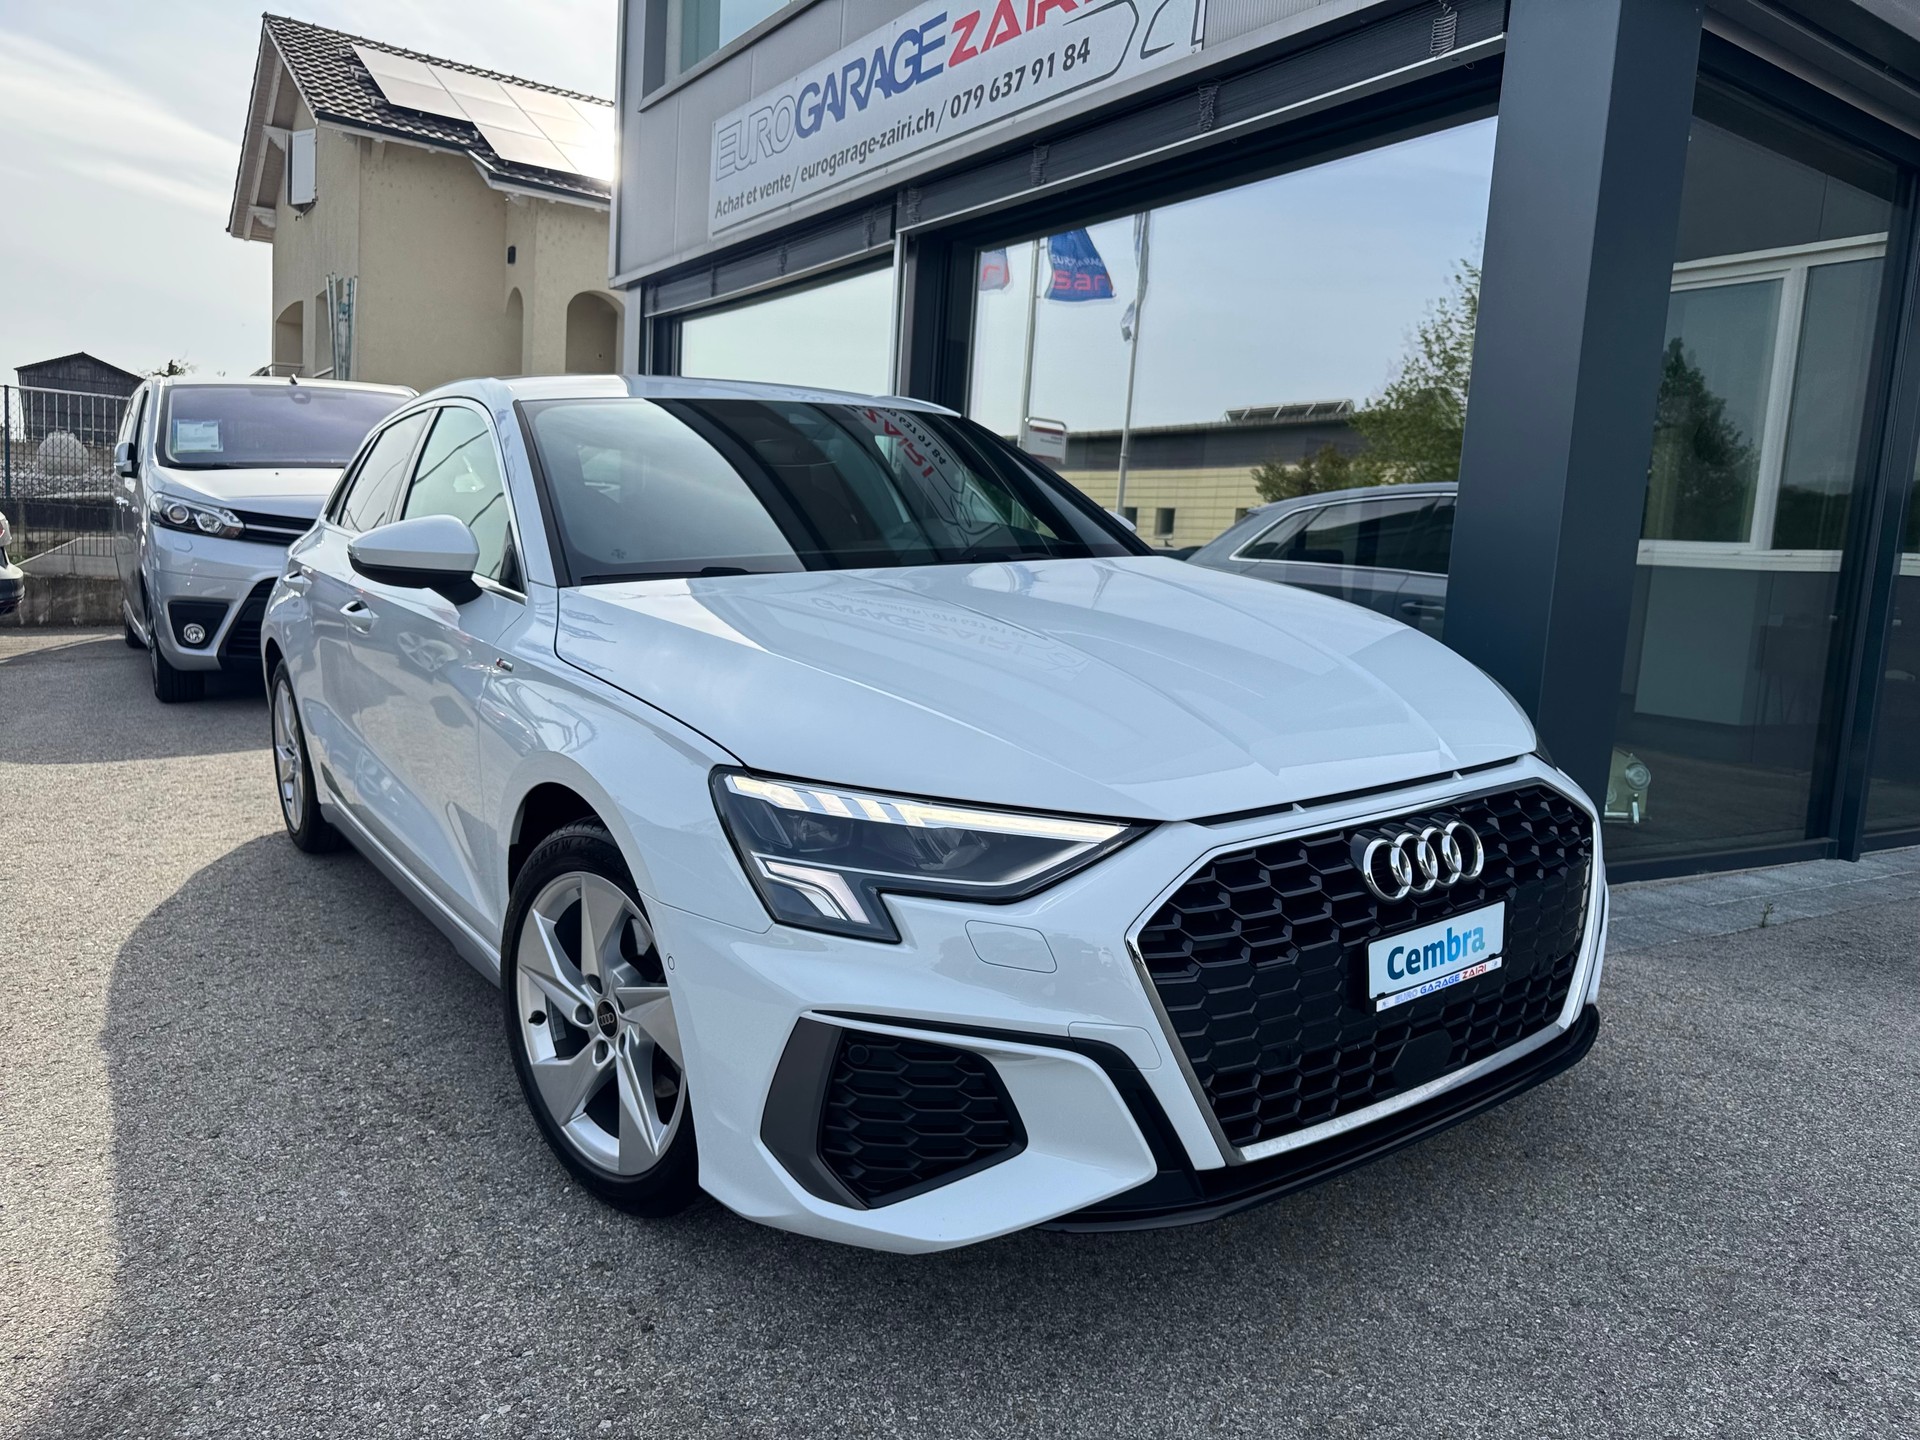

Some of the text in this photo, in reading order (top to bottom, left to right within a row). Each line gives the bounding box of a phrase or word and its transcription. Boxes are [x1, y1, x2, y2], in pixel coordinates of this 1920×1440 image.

[715, 193, 745, 219] Achat
[746, 185, 758, 205] et
[760, 173, 791, 200] vente
[801, 107, 935, 182] eurogarage-zairi.ch
[950, 84, 985, 119] 079
[989, 65, 1026, 102] 637
[1031, 52, 1056, 85] 91
[1062, 36, 1091, 72] 84
[1387, 926, 1486, 980] Cembra
[1420, 973, 1461, 995] GARAGE
[1462, 964, 1487, 980] ZAIRI
